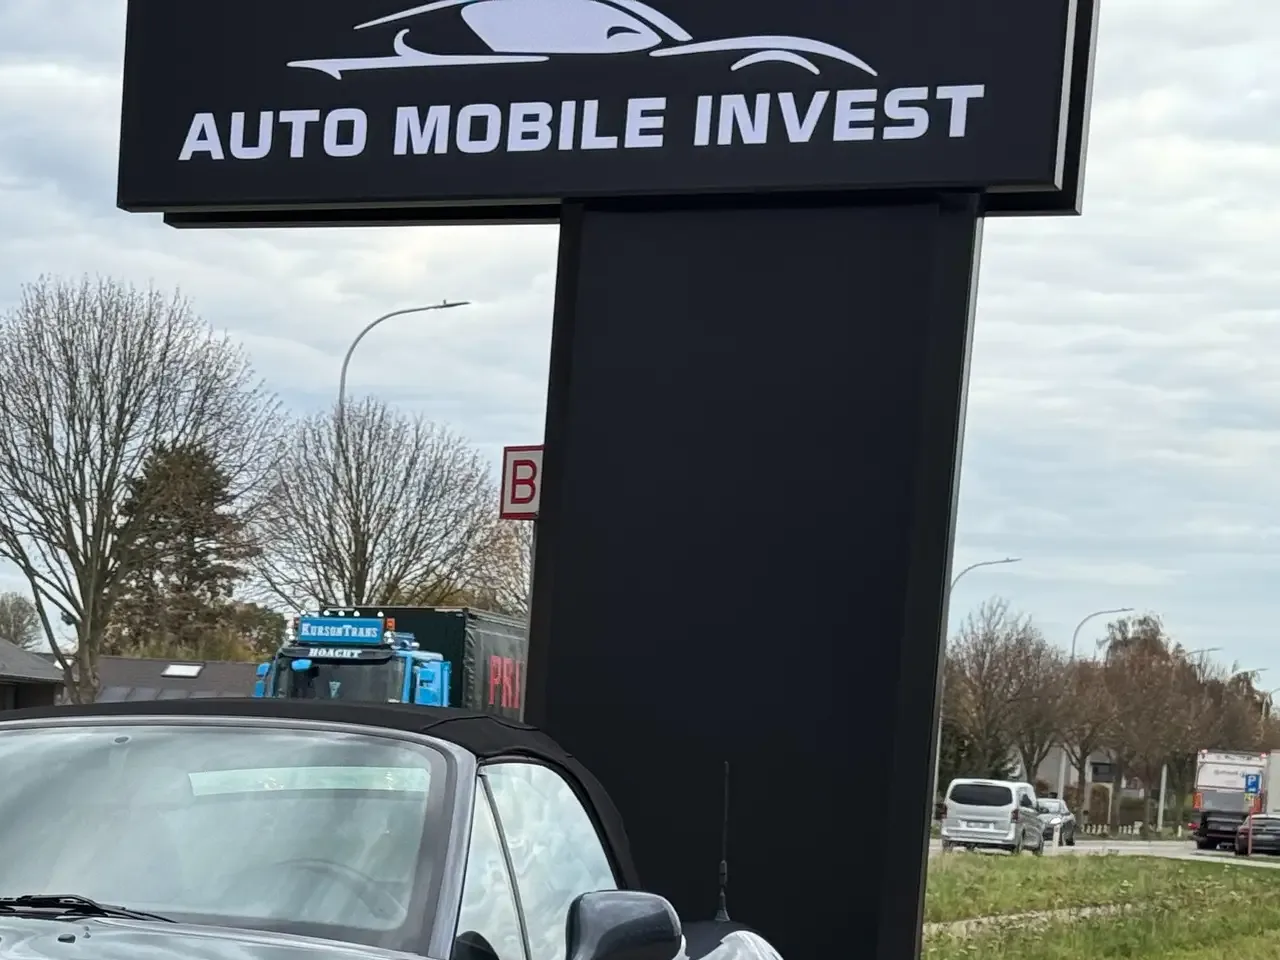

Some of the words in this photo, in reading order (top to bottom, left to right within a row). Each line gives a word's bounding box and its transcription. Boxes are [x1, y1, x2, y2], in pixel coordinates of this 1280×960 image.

[178, 108, 368, 161] AUTO
[393, 97, 667, 155] MOBILE
[693, 84, 985, 146] INVEST
[511, 460, 537, 504] B
